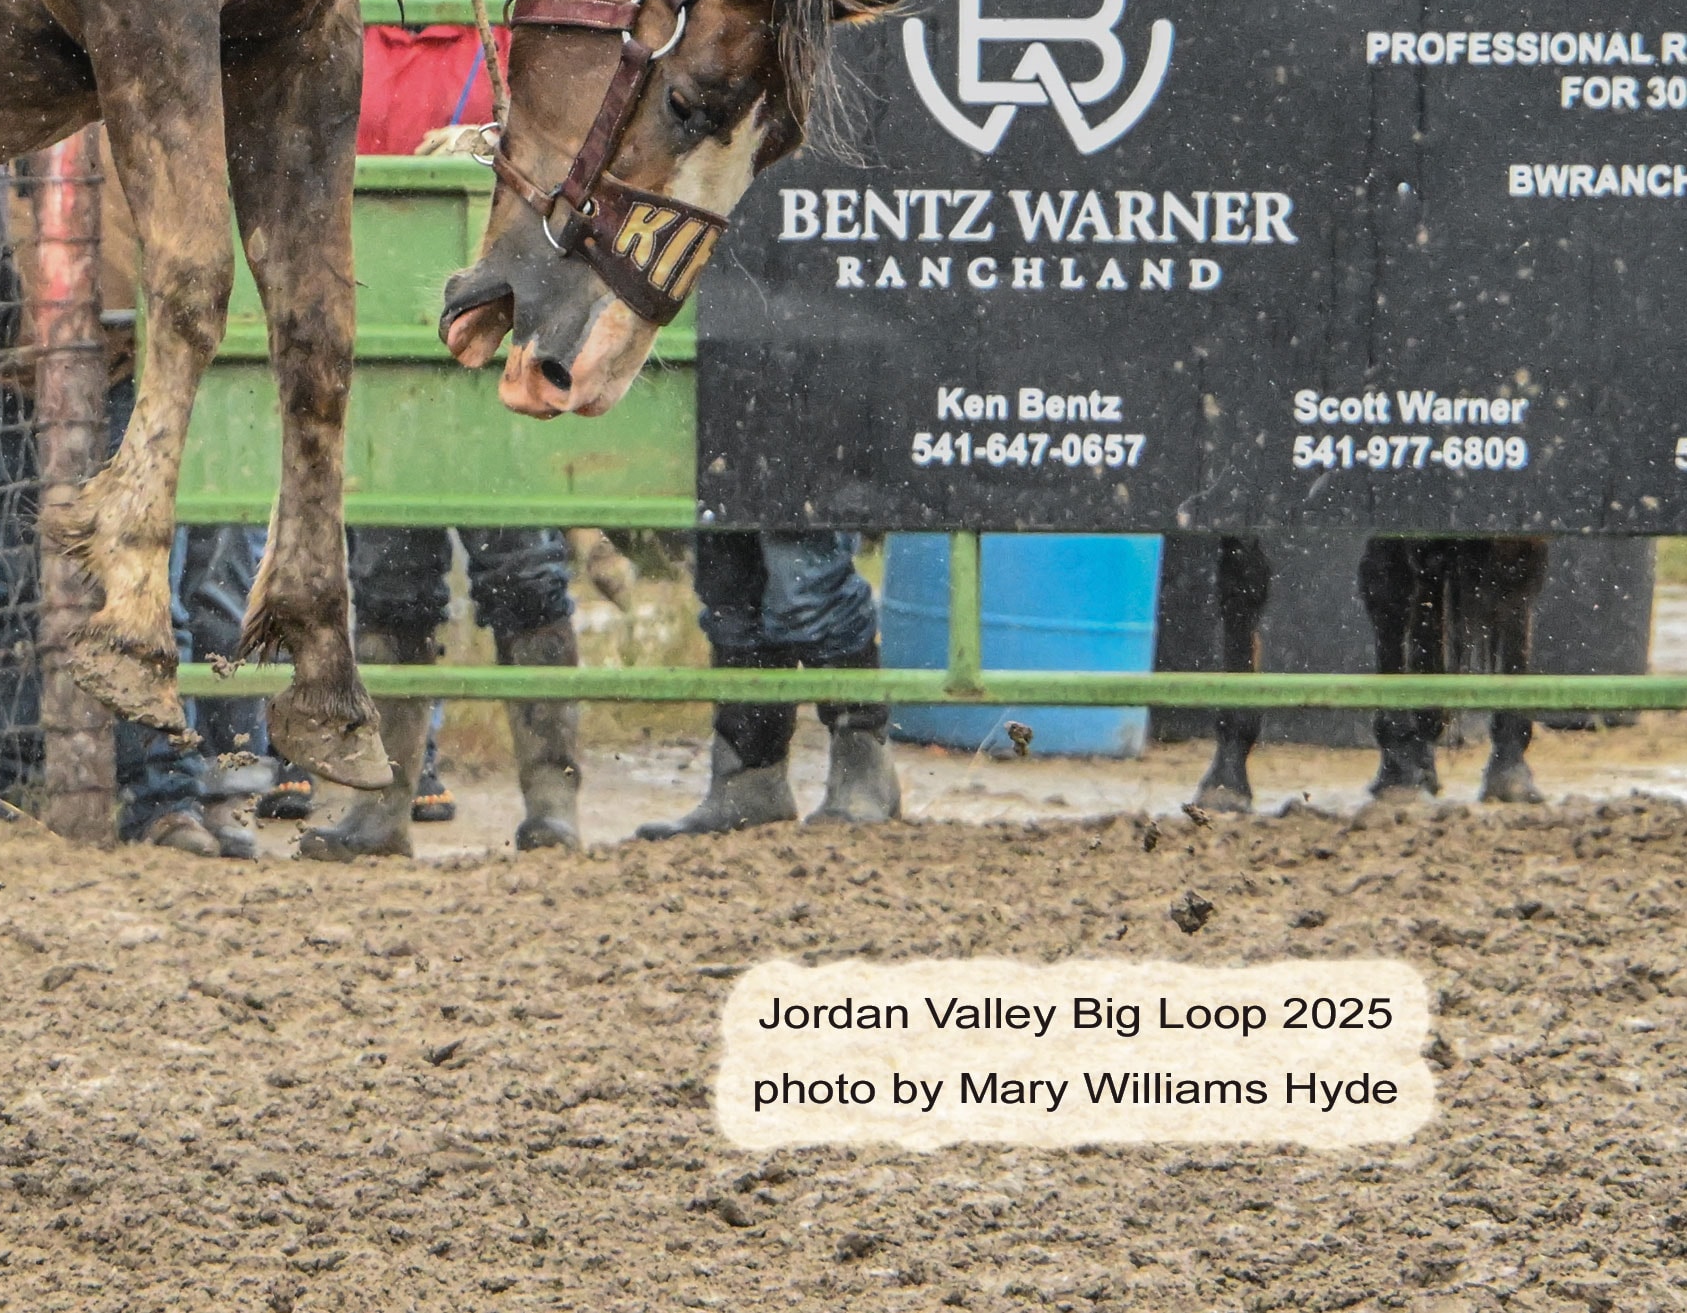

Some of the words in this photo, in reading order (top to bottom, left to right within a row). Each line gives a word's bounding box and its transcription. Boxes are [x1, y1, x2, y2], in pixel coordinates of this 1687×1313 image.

[1366, 31, 1654, 65] PROFESSIONAL
[1561, 75, 1640, 109] FOR
[1647, 75, 1687, 109] 30
[778, 188, 995, 243] BENTZ
[1008, 190, 1298, 244] WARNER
[836, 256, 1221, 290] RANCHLAND
[938, 387, 1008, 421] Ken
[1019, 387, 1122, 421] Bentz
[1293, 389, 1390, 424] Scott
[1397, 389, 1528, 424] Warner
[912, 432, 1146, 467] 541-647-0657
[1293, 434, 1527, 470] 541-977-6809
